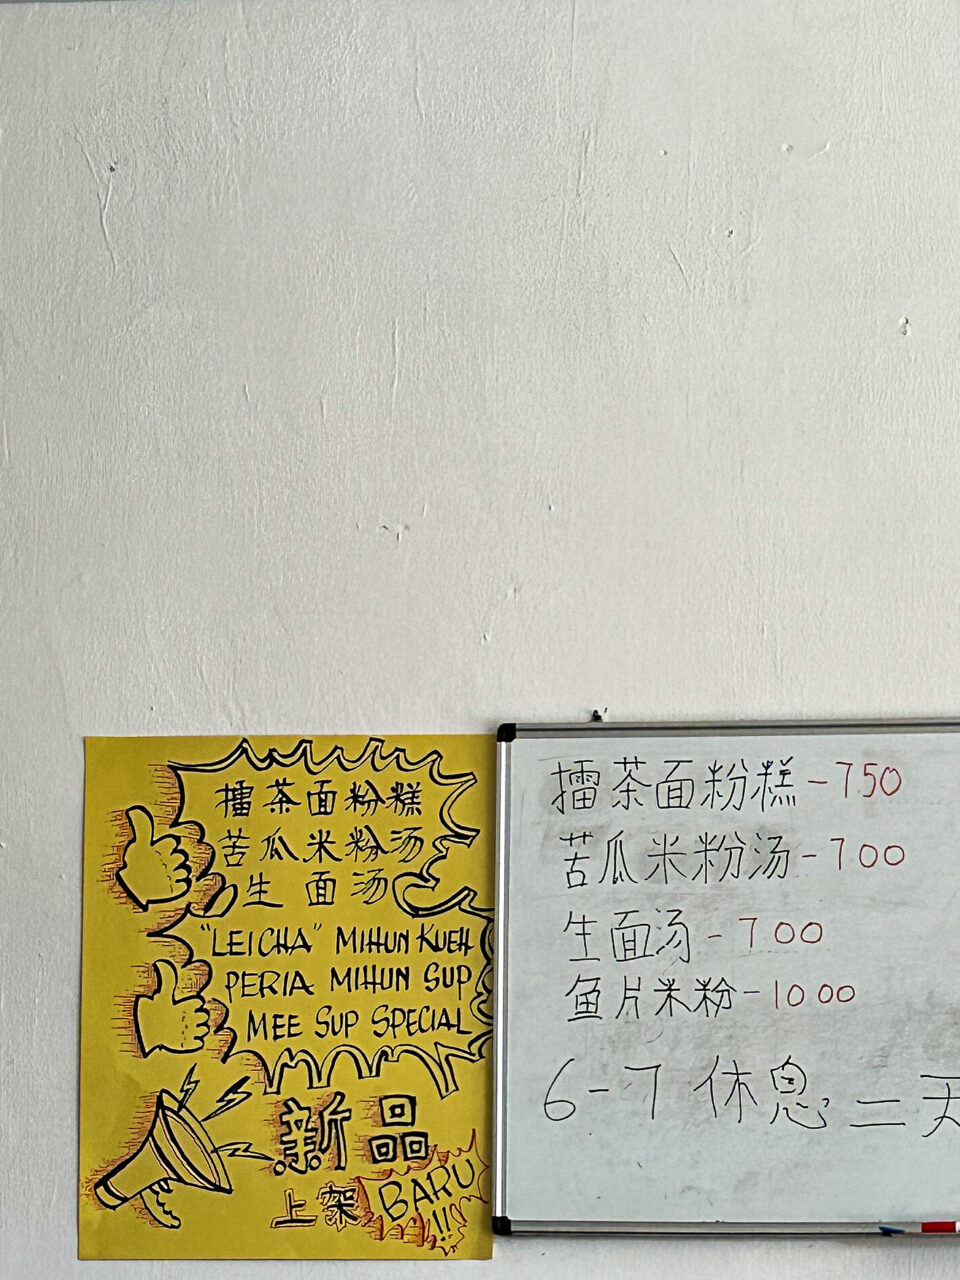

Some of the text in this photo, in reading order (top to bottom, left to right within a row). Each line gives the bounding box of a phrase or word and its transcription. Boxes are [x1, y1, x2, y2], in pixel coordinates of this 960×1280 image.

[220, 824, 425, 868] 苦瓜米粉汤
[335, 926, 410, 955] MIHUN
[416, 923, 475, 956] KUEH
[225, 962, 473, 1004] PERIA MIHUN SUP
[247, 1004, 473, 1042] MEE SUP SPECIAL
[273, 1090, 430, 1176] 新品
[270, 1182, 364, 1232] 上架
